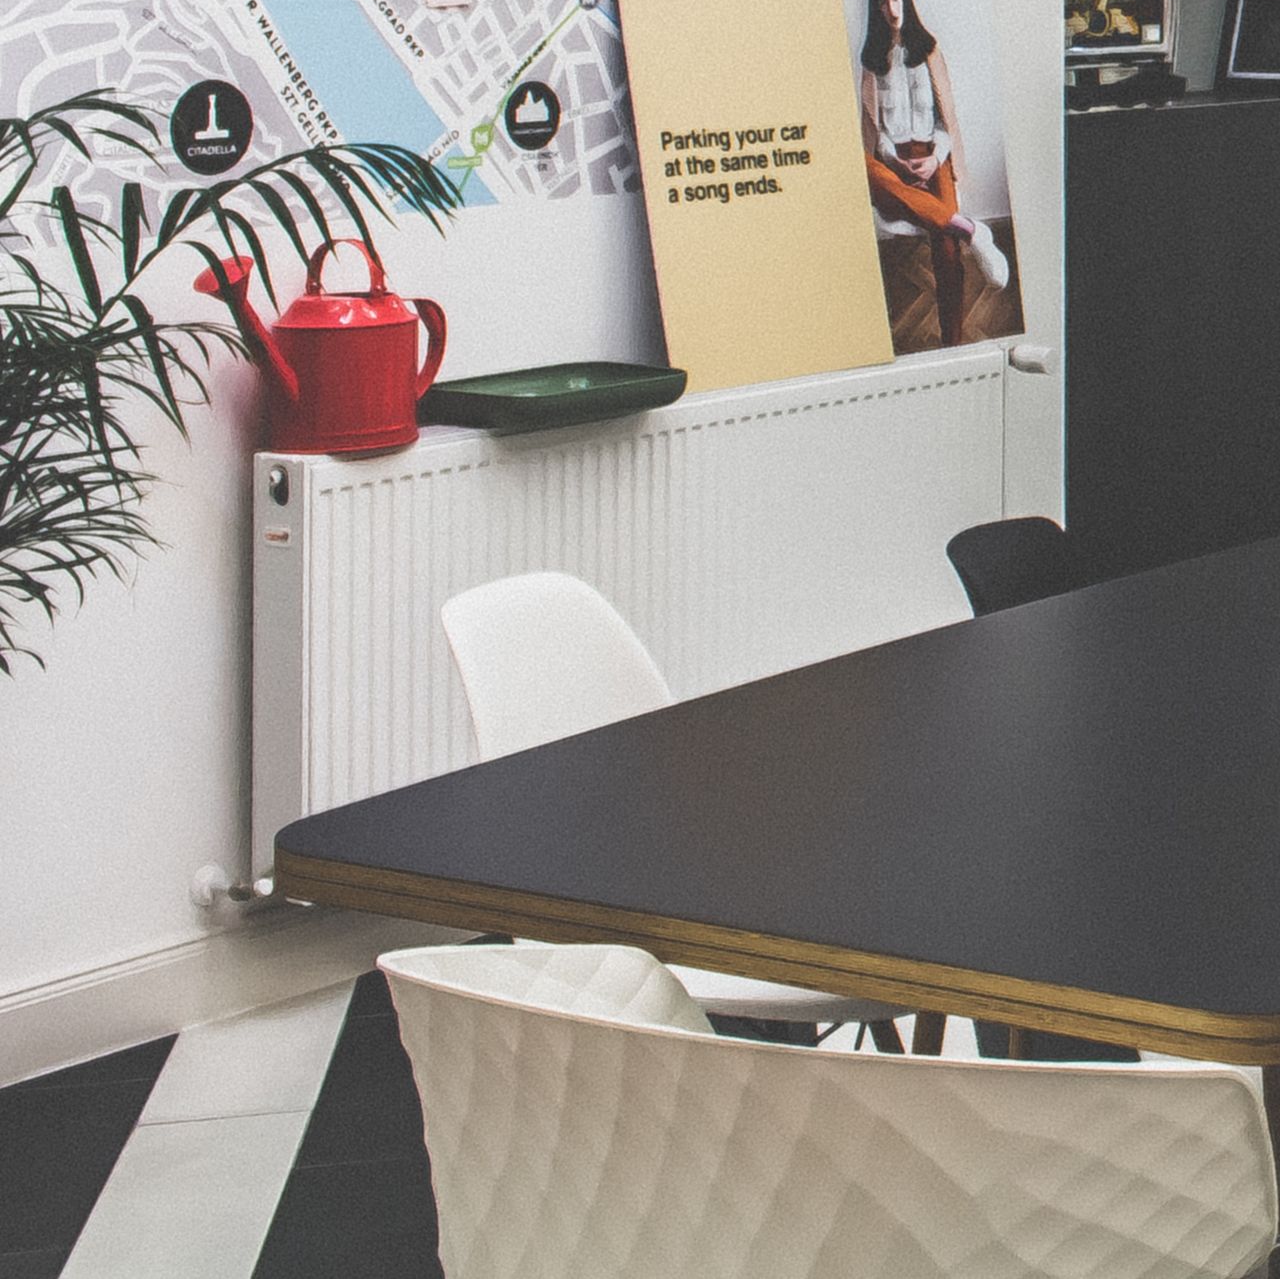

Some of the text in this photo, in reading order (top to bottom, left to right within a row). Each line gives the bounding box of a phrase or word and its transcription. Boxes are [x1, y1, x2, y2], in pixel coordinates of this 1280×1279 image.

[257, 14, 320, 112] WALLENBERG
[186, 144, 238, 158] CITADELLA
[660, 124, 808, 152] Parking your car
[664, 148, 811, 178] at the same time
[668, 175, 784, 204] a song ends.
